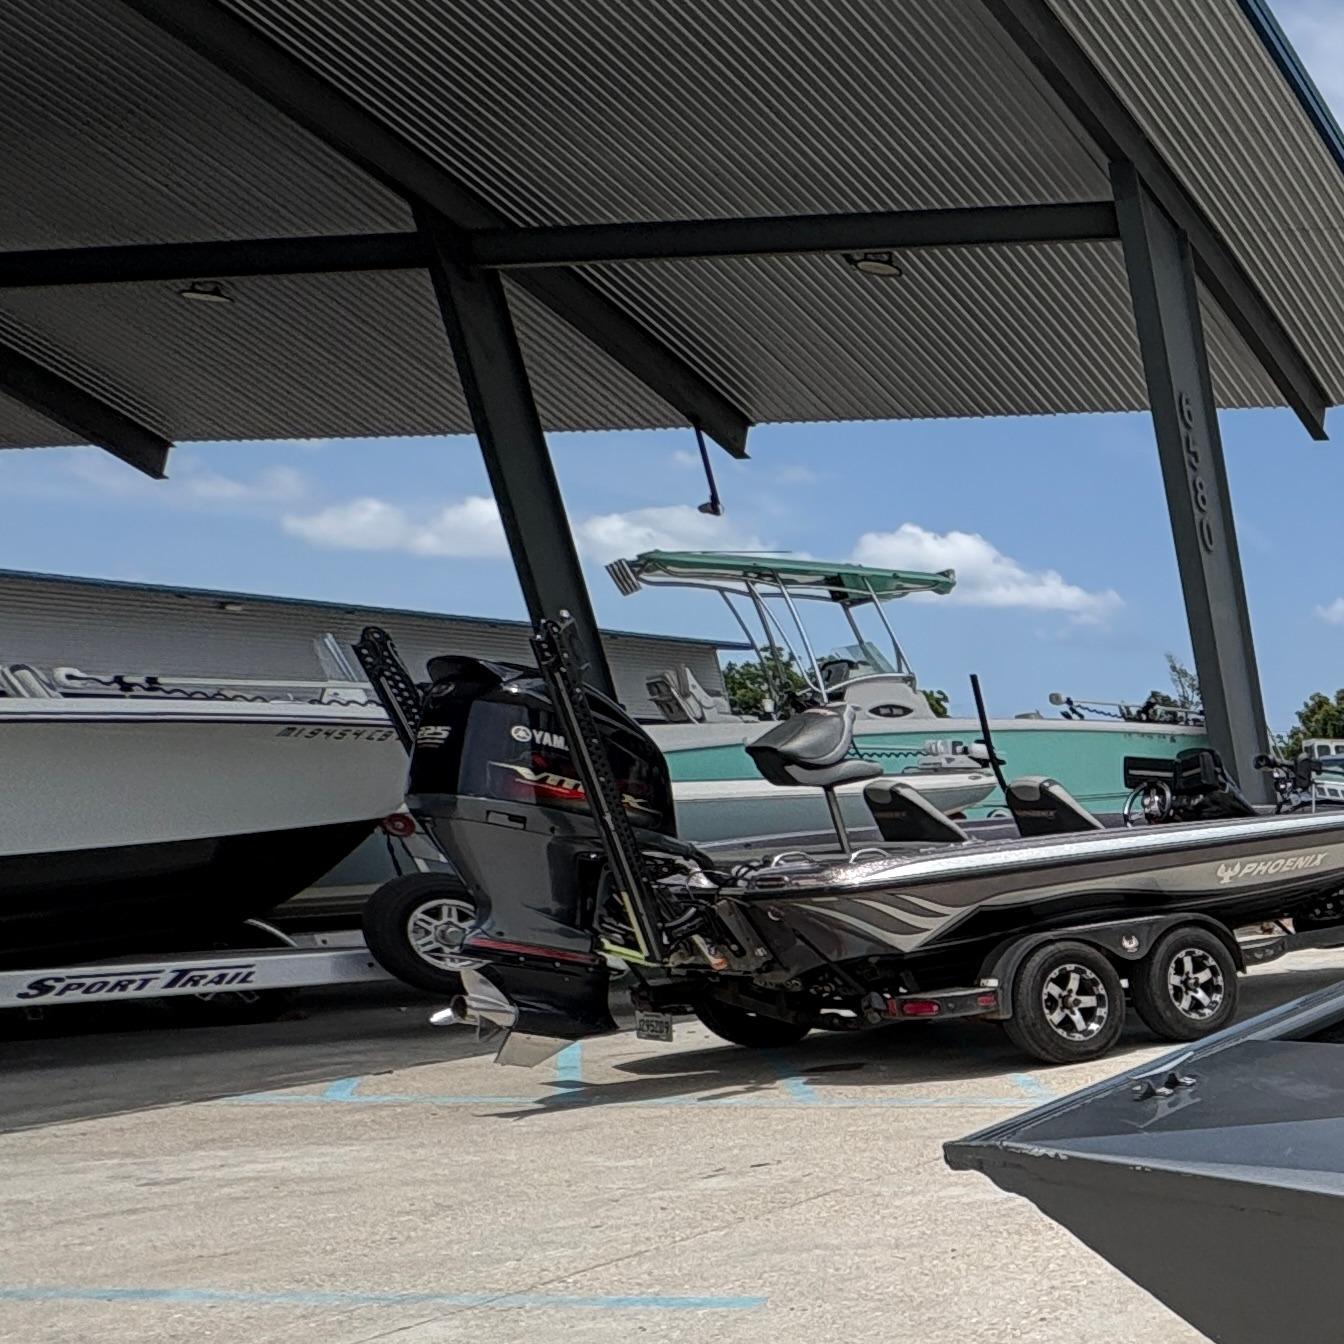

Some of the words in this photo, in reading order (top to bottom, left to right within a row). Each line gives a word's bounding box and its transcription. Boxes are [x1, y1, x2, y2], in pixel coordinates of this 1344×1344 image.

[533, 729, 570, 751] YAM
[1238, 852, 1328, 878] PHOENIX
[17, 971, 162, 1000] SPORT
[161, 963, 257, 990] TRAIL
